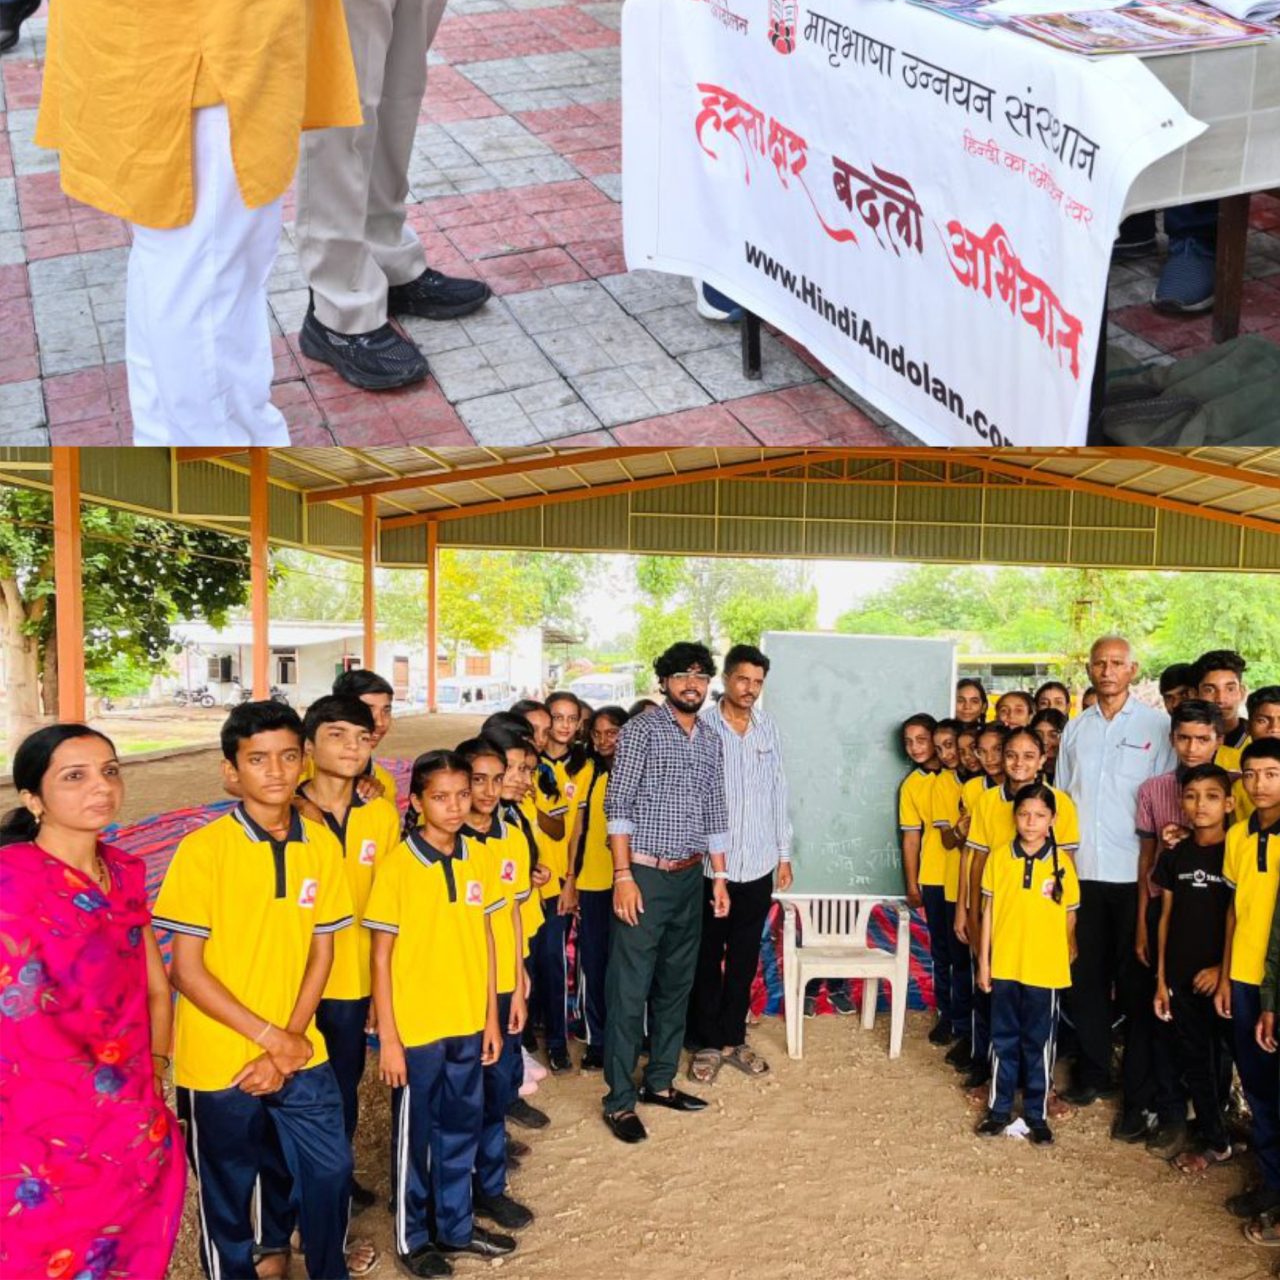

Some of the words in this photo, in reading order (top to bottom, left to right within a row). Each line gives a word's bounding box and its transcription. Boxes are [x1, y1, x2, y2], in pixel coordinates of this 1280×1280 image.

[803, 8, 898, 79] मातृभाषा
[900, 50, 997, 125] उन्नयन
[1003, 86, 1101, 181] संस्थान
[694, 82, 858, 247] हस्ताक्षर
[932, 219, 1083, 382] अभियान
